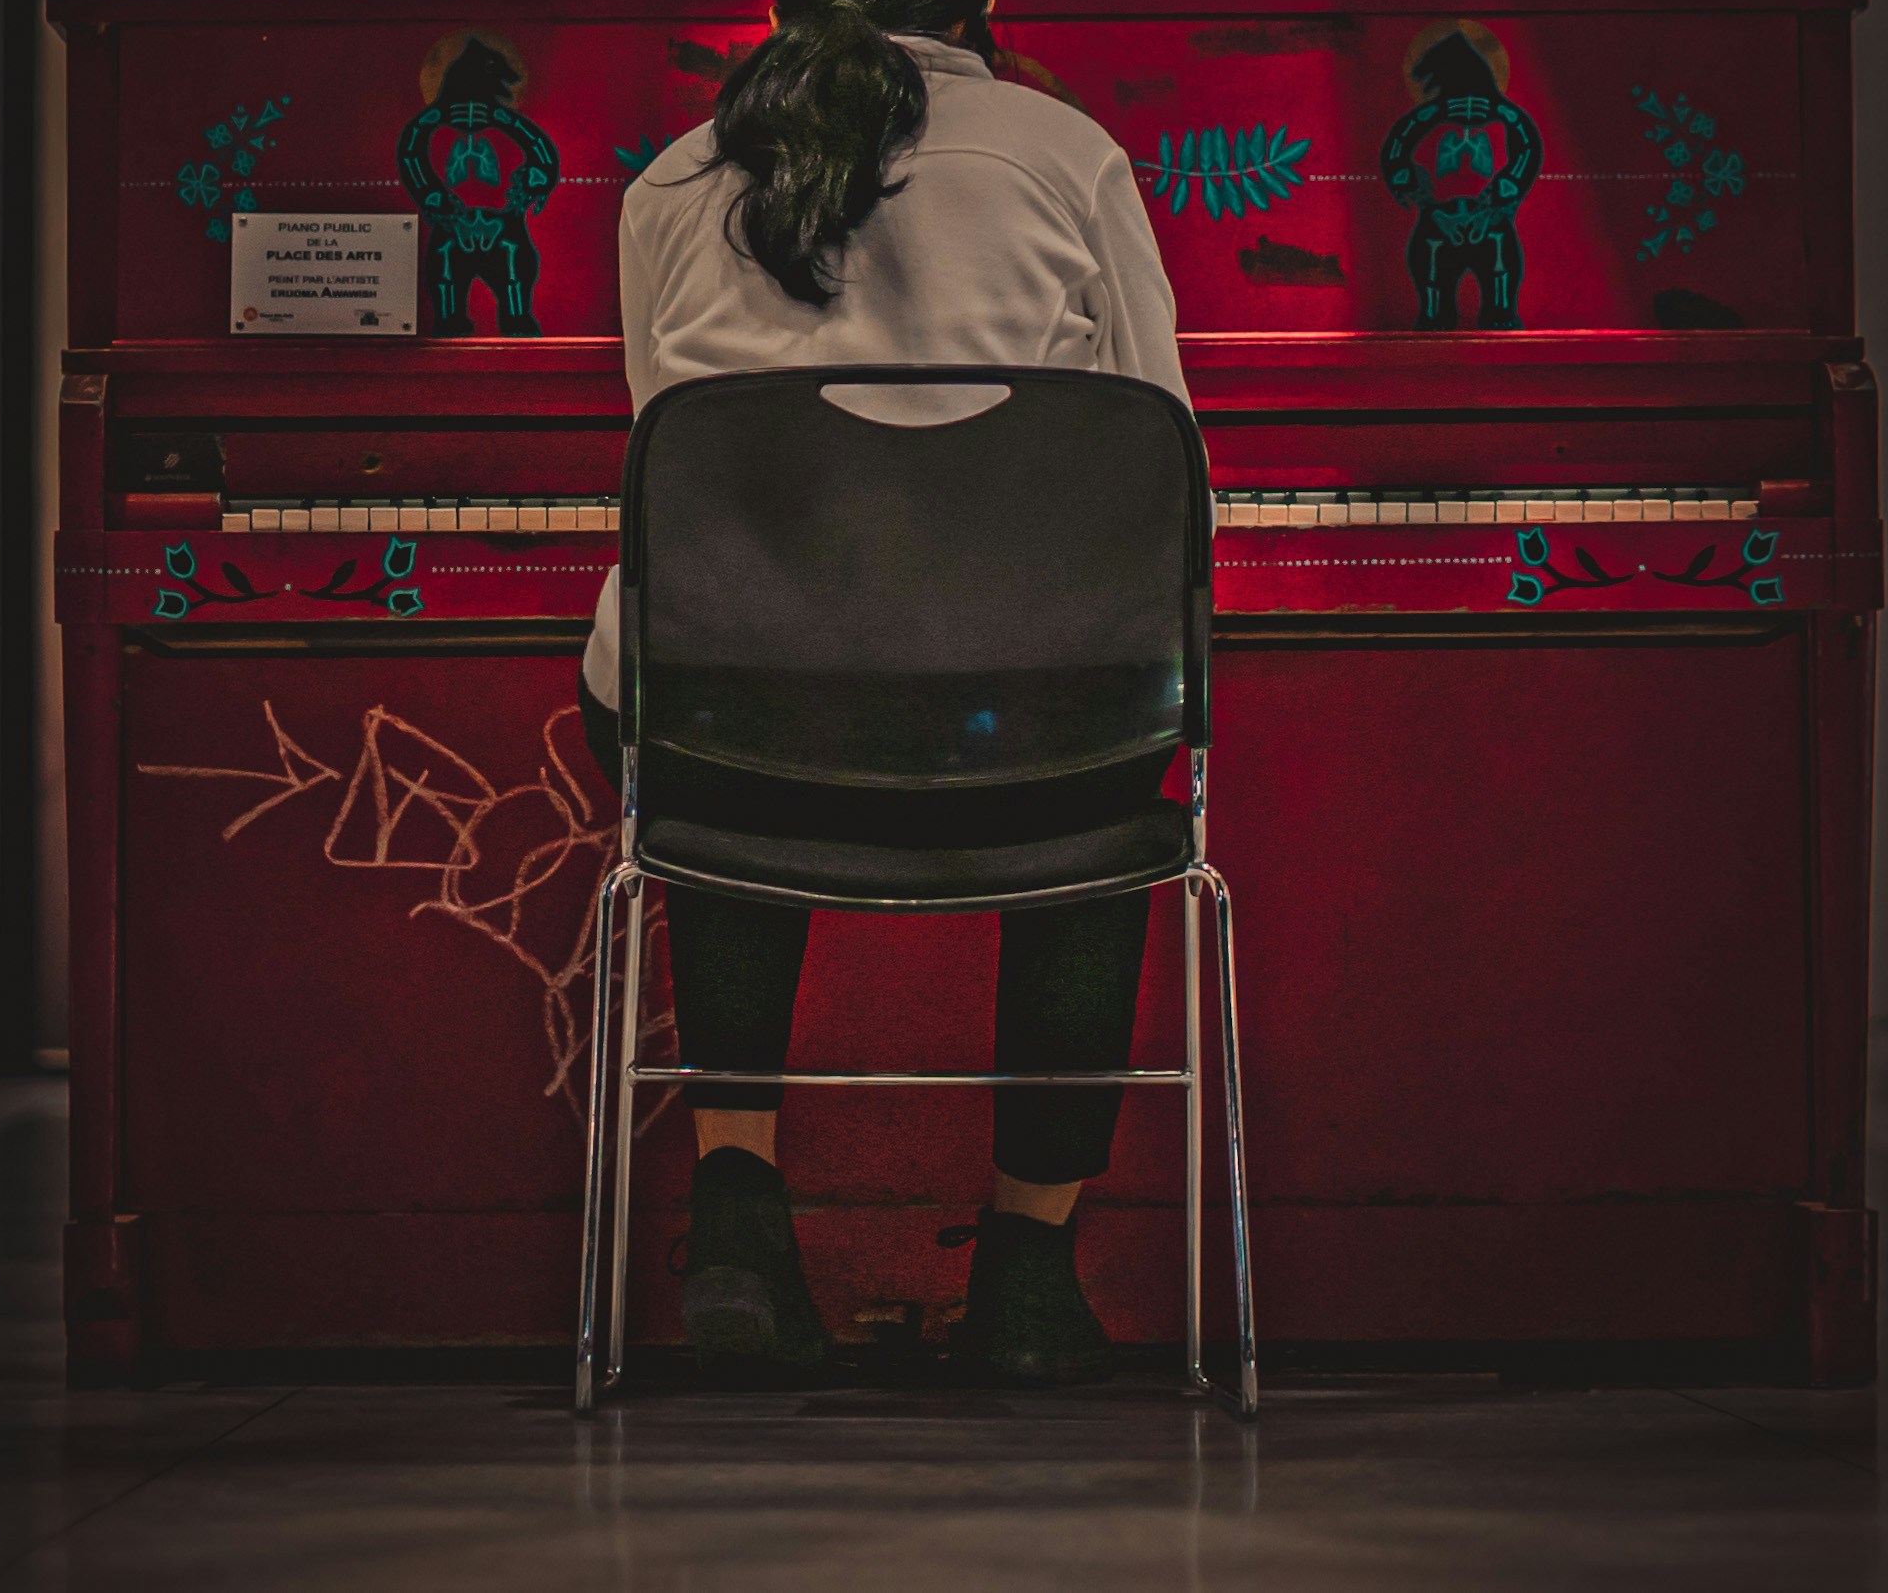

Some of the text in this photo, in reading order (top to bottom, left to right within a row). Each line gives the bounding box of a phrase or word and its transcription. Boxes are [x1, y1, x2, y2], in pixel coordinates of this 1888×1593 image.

[278, 222, 372, 233] PIANO PUBLIC
[307, 238, 338, 247] DE LA
[266, 250, 382, 261] PLACE DES ARTS
[268, 275, 380, 285] PEINT PAR L'ARTISTE
